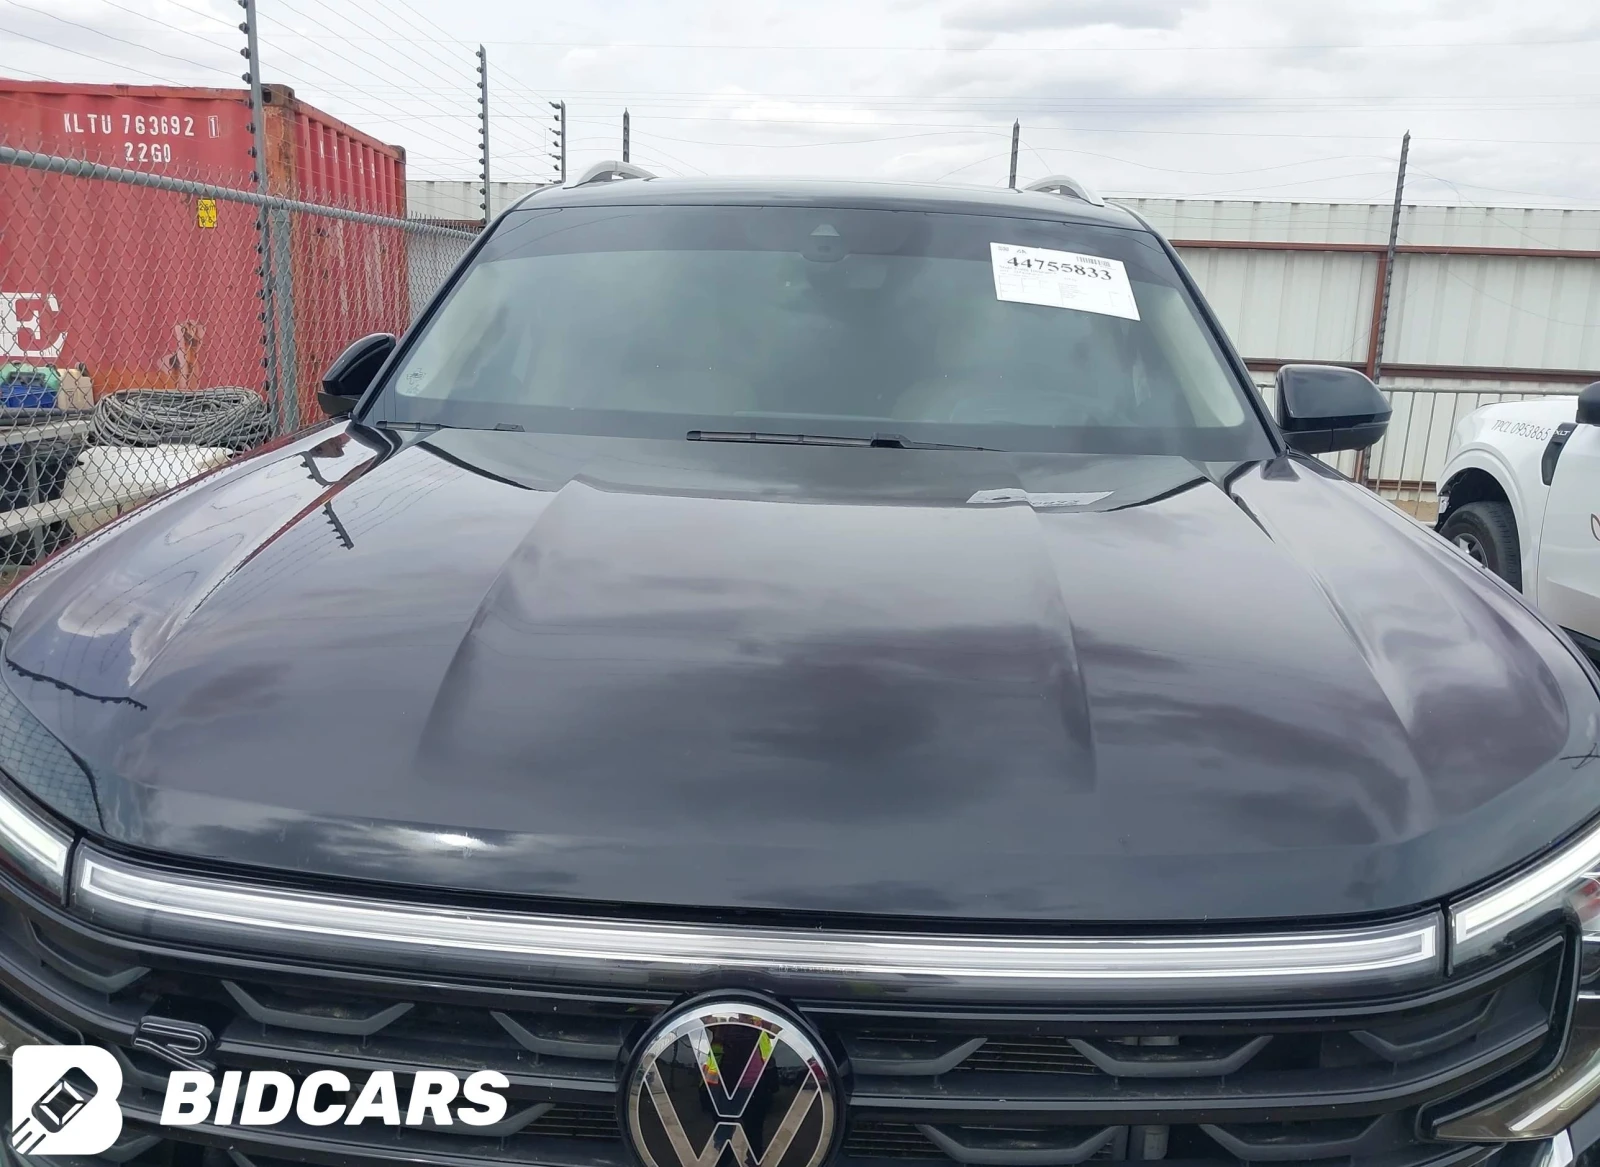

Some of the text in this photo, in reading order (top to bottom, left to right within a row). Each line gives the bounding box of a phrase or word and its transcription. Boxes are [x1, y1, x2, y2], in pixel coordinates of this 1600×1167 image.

[63, 113, 112, 135] KLTU
[122, 114, 195, 137] 763692
[1007, 256, 1113, 281] 44755833
[1510, 422, 1552, 442] 0953865
[1553, 429, 1571, 437] XLT
